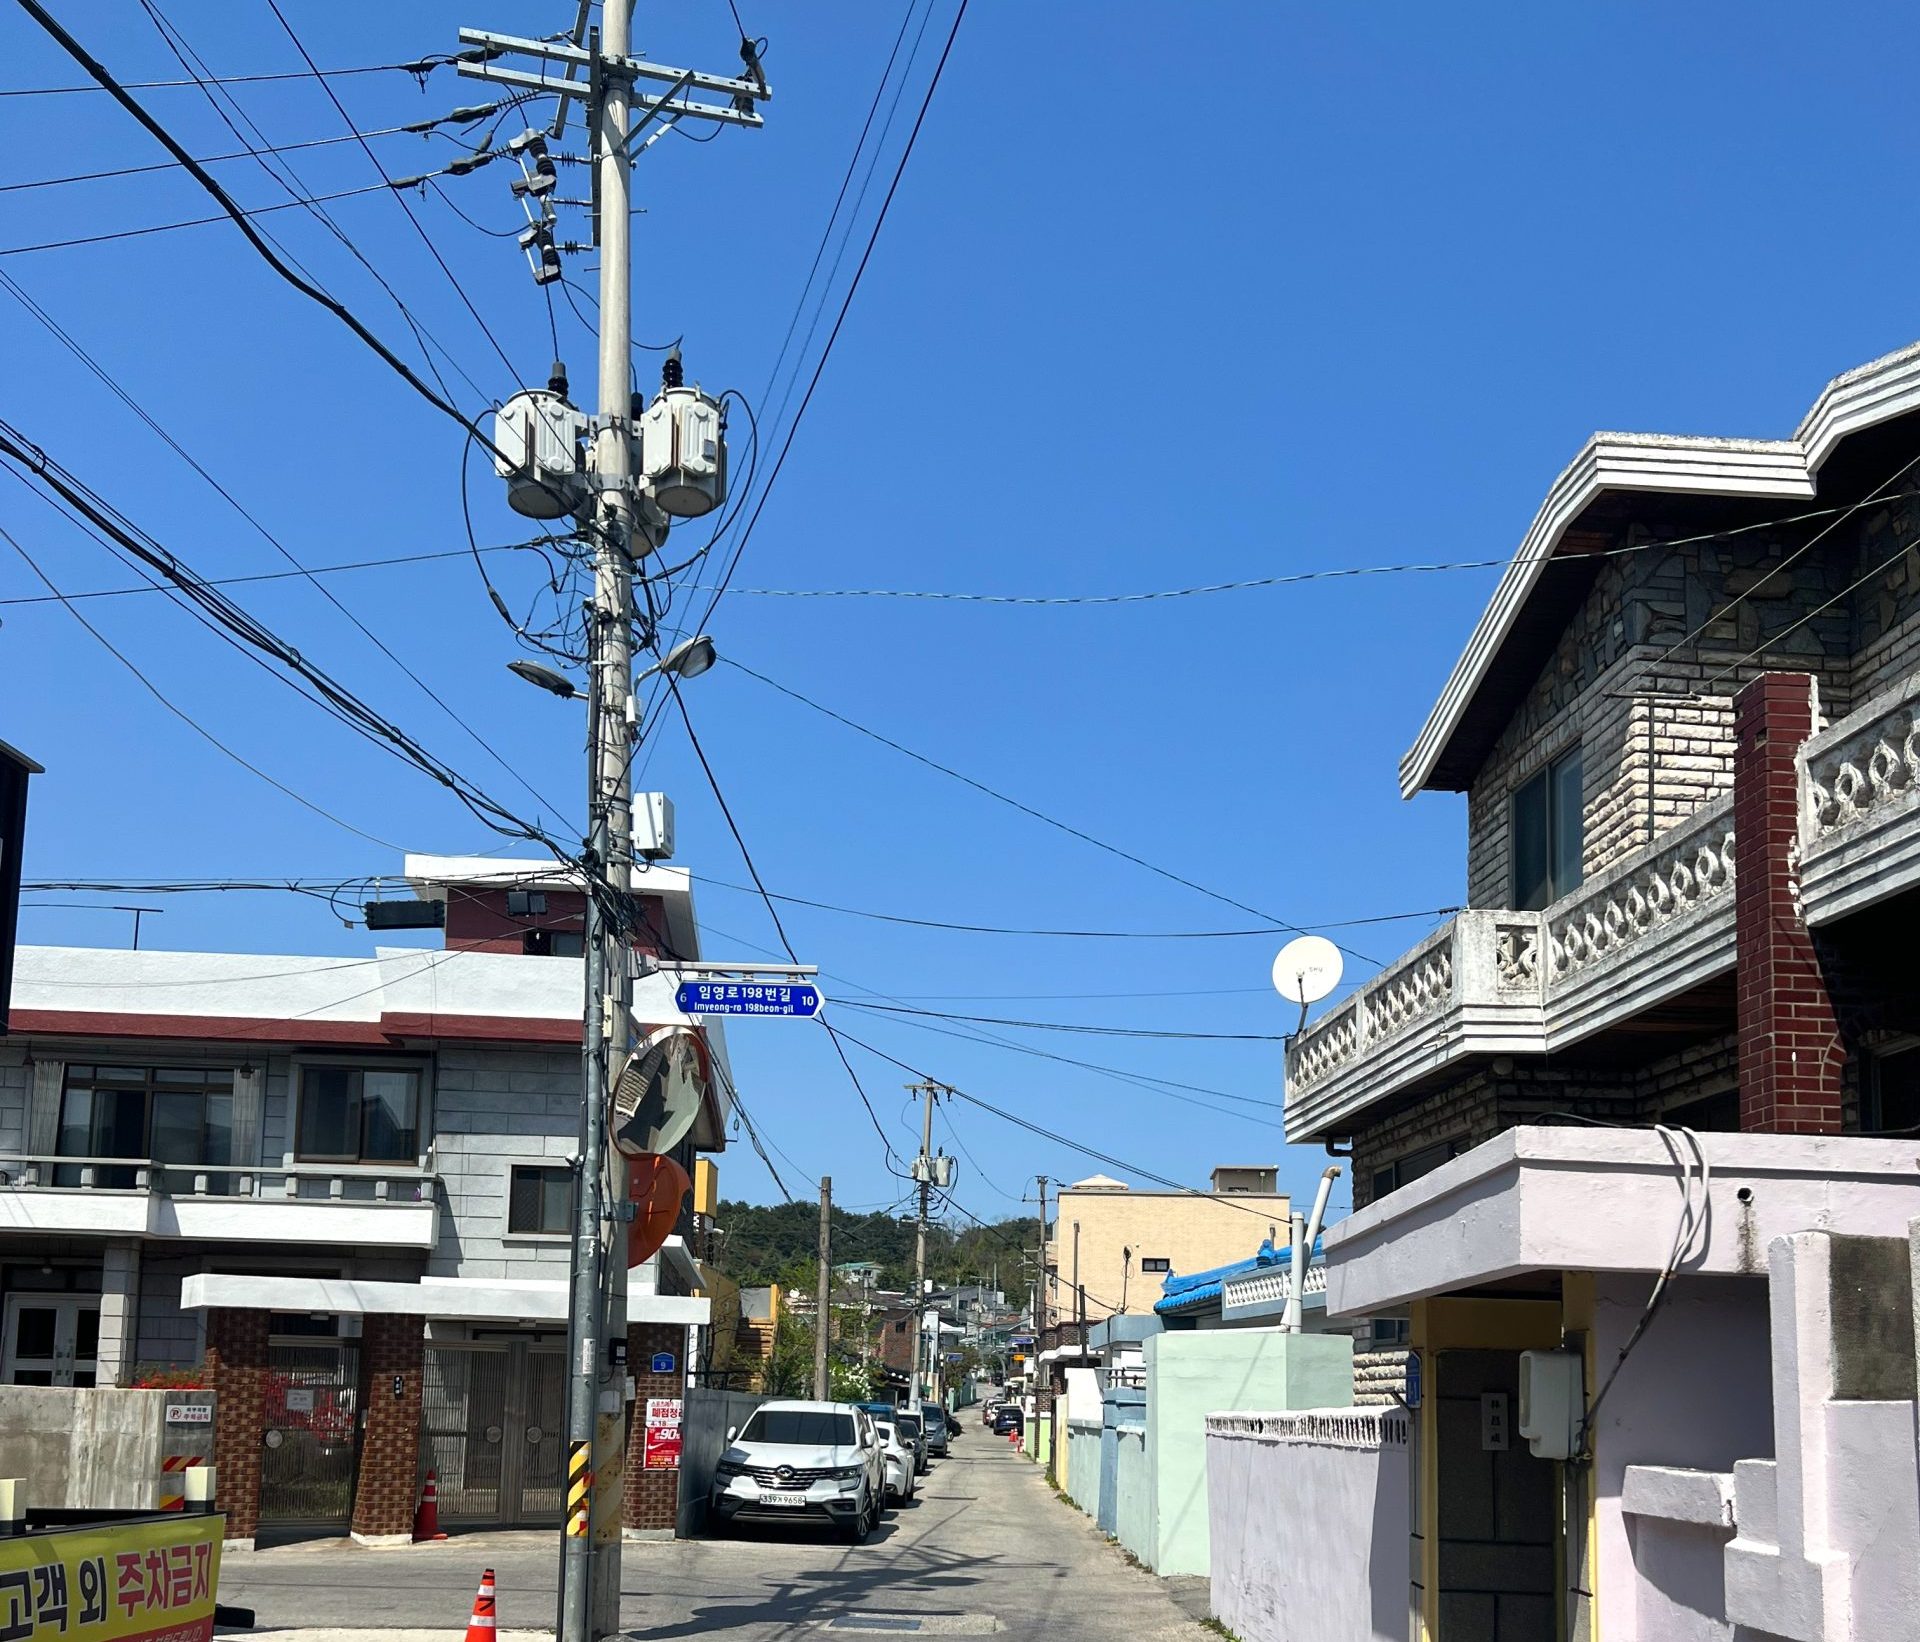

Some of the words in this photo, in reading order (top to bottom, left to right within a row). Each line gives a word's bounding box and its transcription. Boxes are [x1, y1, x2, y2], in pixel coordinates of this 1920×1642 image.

[680, 992, 687, 1003] 6
[802, 995, 814, 1007] 10
[694, 1002, 742, 1013] Imyeong-ro
[745, 1003, 794, 1014] 198beon-gil
[660, 1361, 667, 1370] 9
[0, 1563, 68, 1642] 고객
[79, 1556, 107, 1624] 외
[116, 1541, 213, 1618] 주차금지
